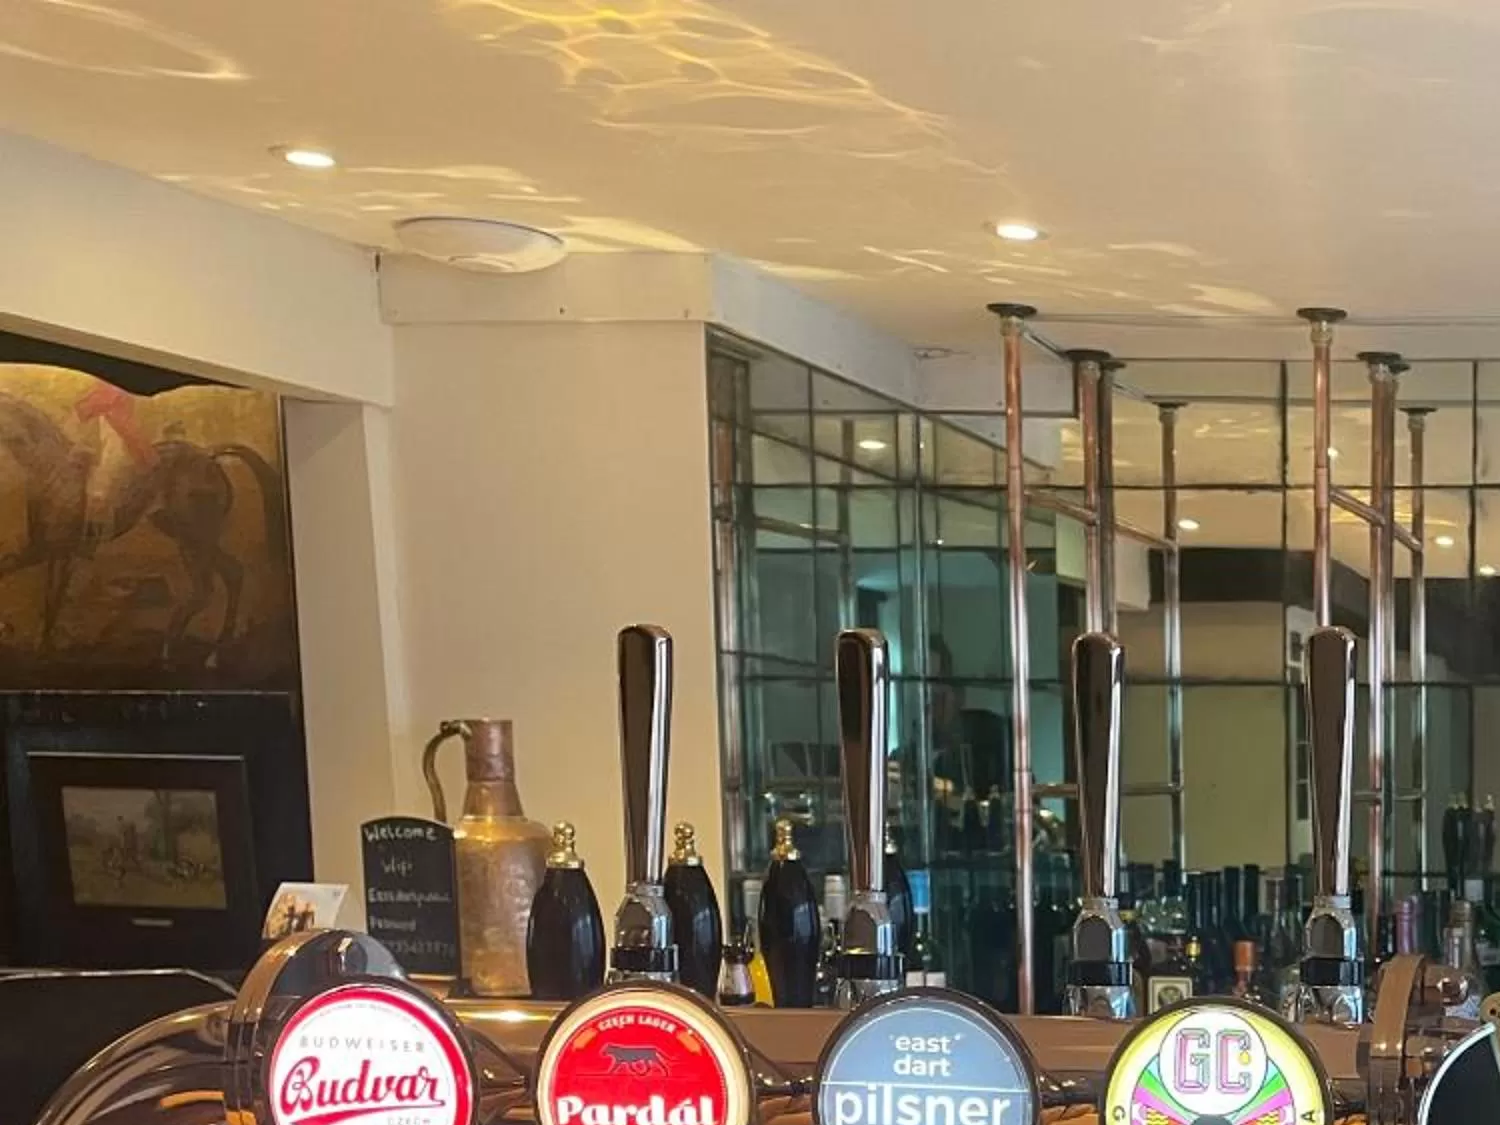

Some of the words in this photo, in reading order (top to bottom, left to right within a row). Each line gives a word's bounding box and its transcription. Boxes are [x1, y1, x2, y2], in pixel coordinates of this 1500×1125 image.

[638, 1014, 677, 1034] LAGER
[299, 1036, 426, 1053] BUDWEISER
[895, 1034, 952, 1054] east
[893, 1055, 951, 1077] dart
[1174, 1028, 1252, 1094] GC
[280, 1055, 446, 1115] Budvar
